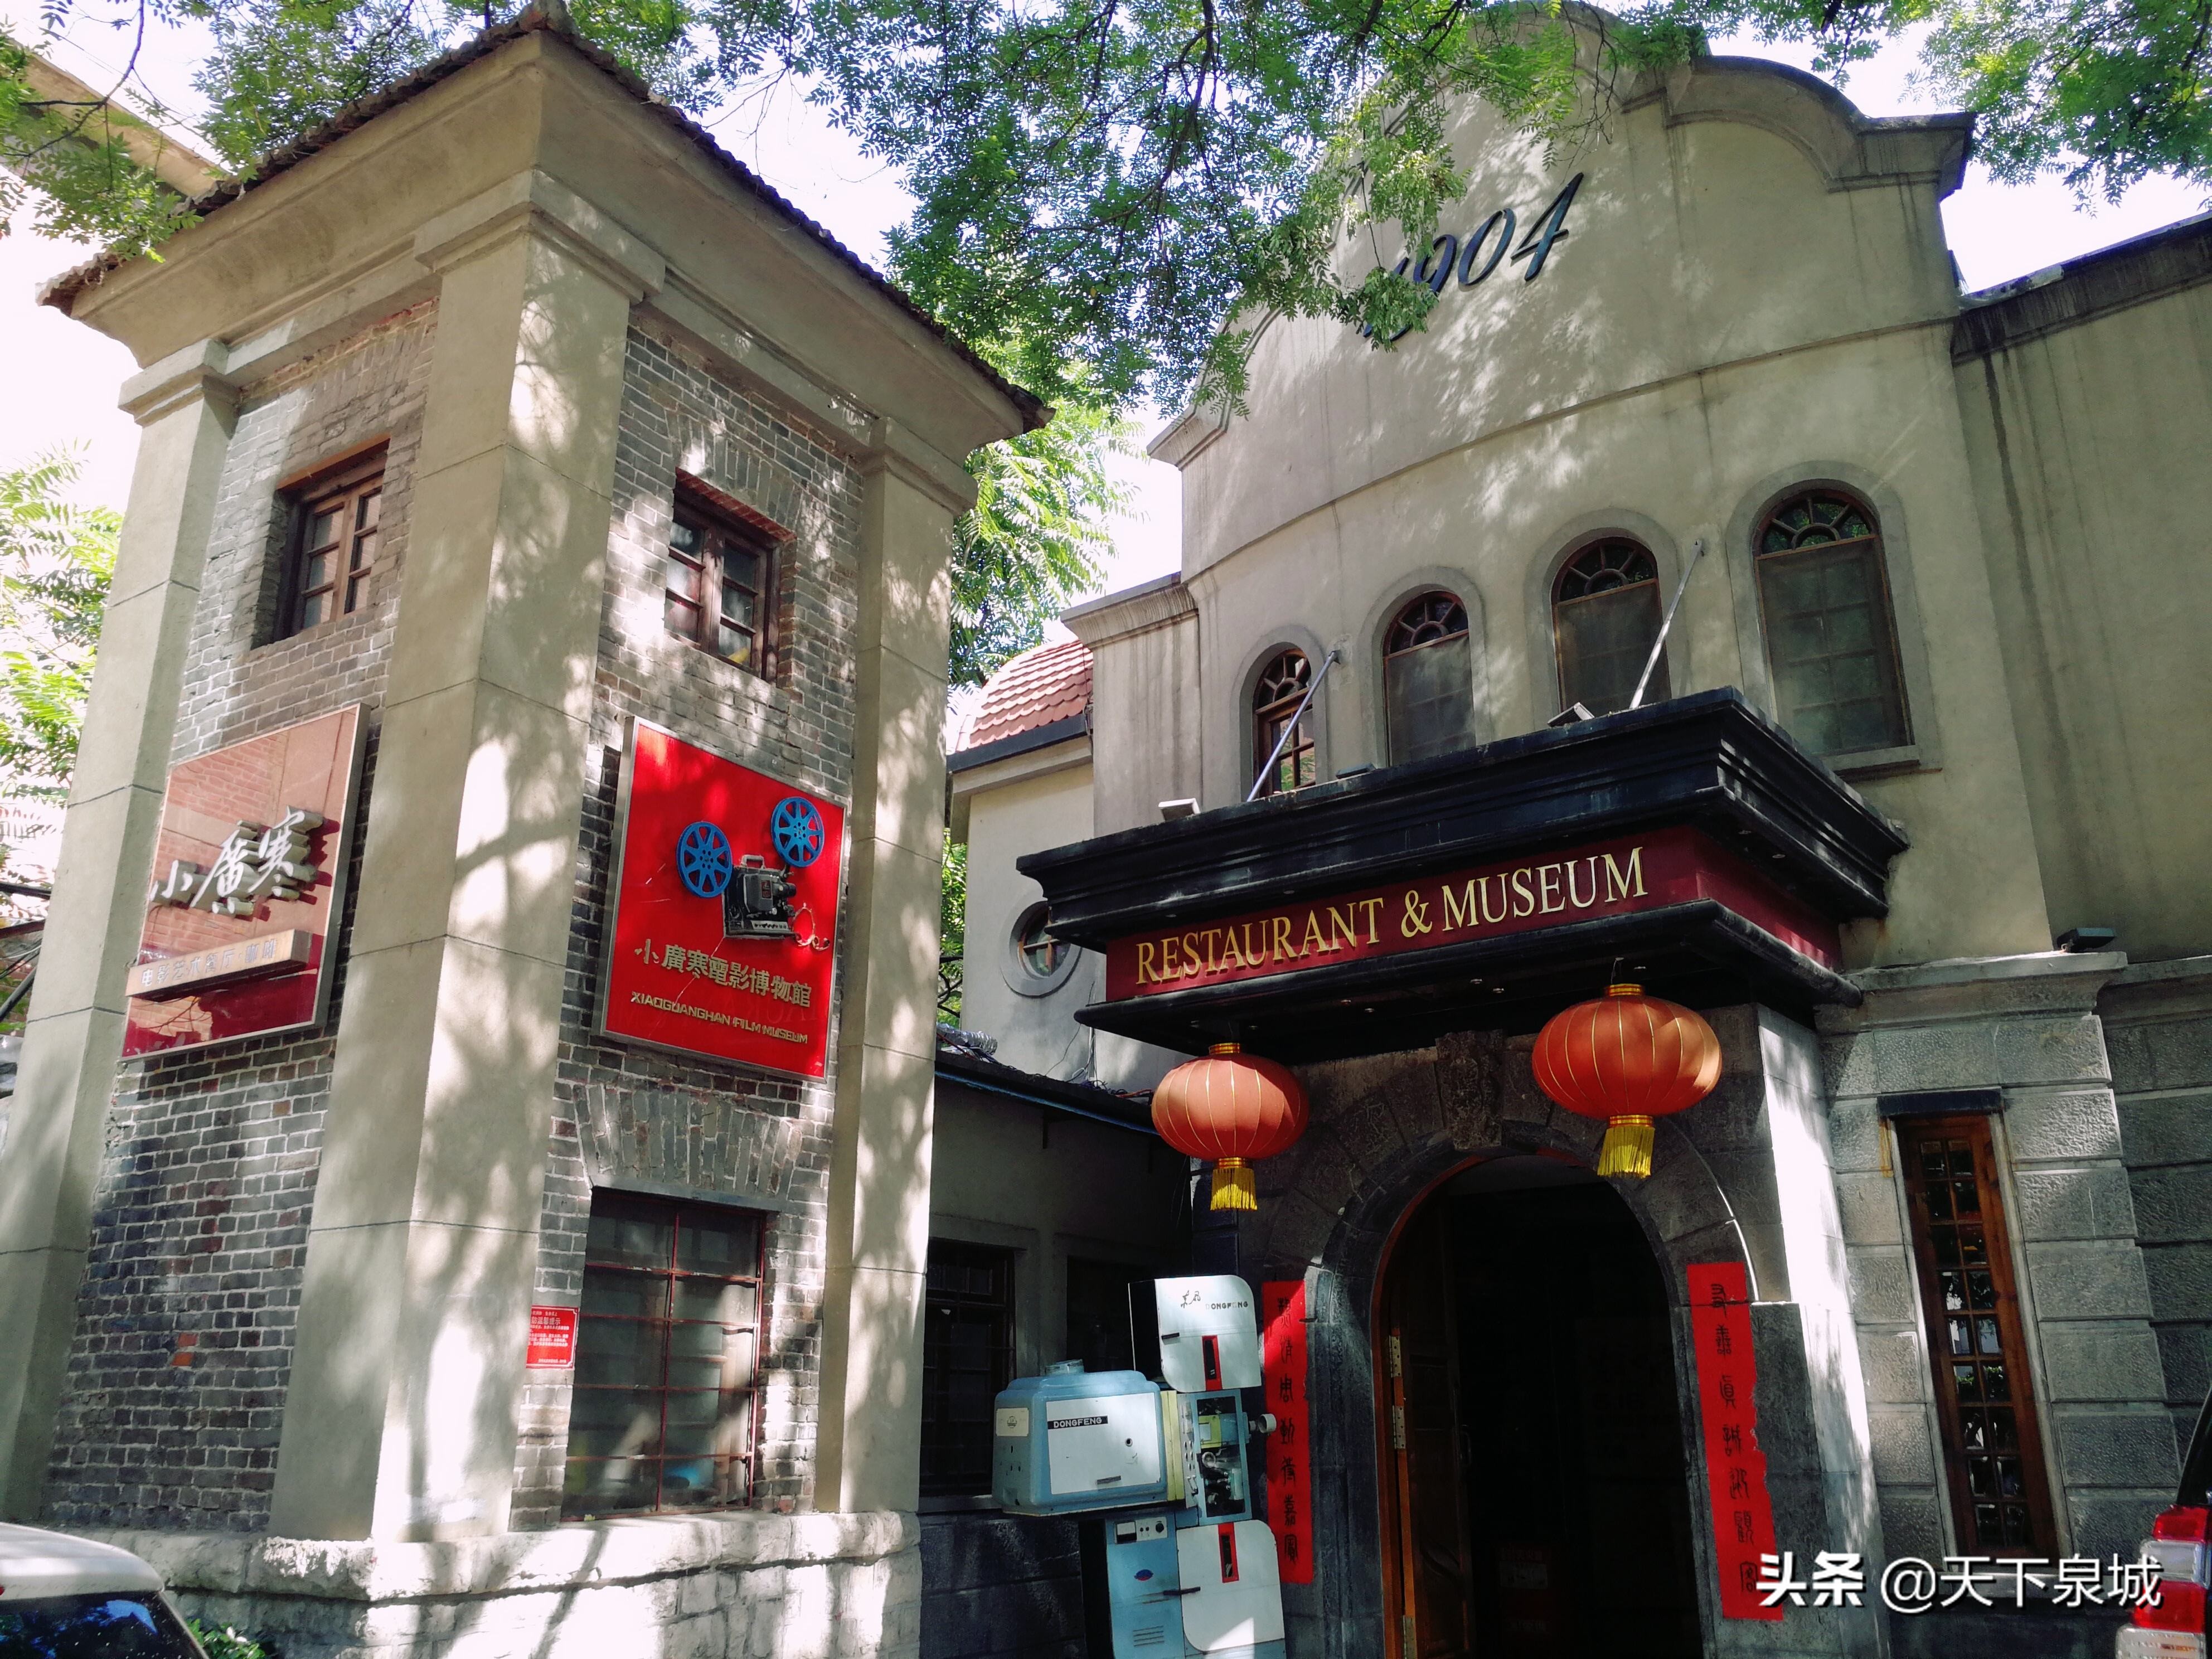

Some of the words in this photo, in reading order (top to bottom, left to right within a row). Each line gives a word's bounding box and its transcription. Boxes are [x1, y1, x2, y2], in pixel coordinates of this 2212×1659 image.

[1362, 172, 1584, 341] 904
[1136, 897, 1385, 986] RESTAURANT
[1400, 890, 1433, 939] &
[1442, 846, 1648, 932] MUSEUM
[634, 938, 813, 1008] 小廣寒電影博物館
[631, 991, 731, 1026] XIAOGUANGHAN
[733, 1017, 761, 1033] FILM
[761, 1024, 808, 1044] MUSEUM
[1053, 1417, 1103, 1429] DONGFENG
